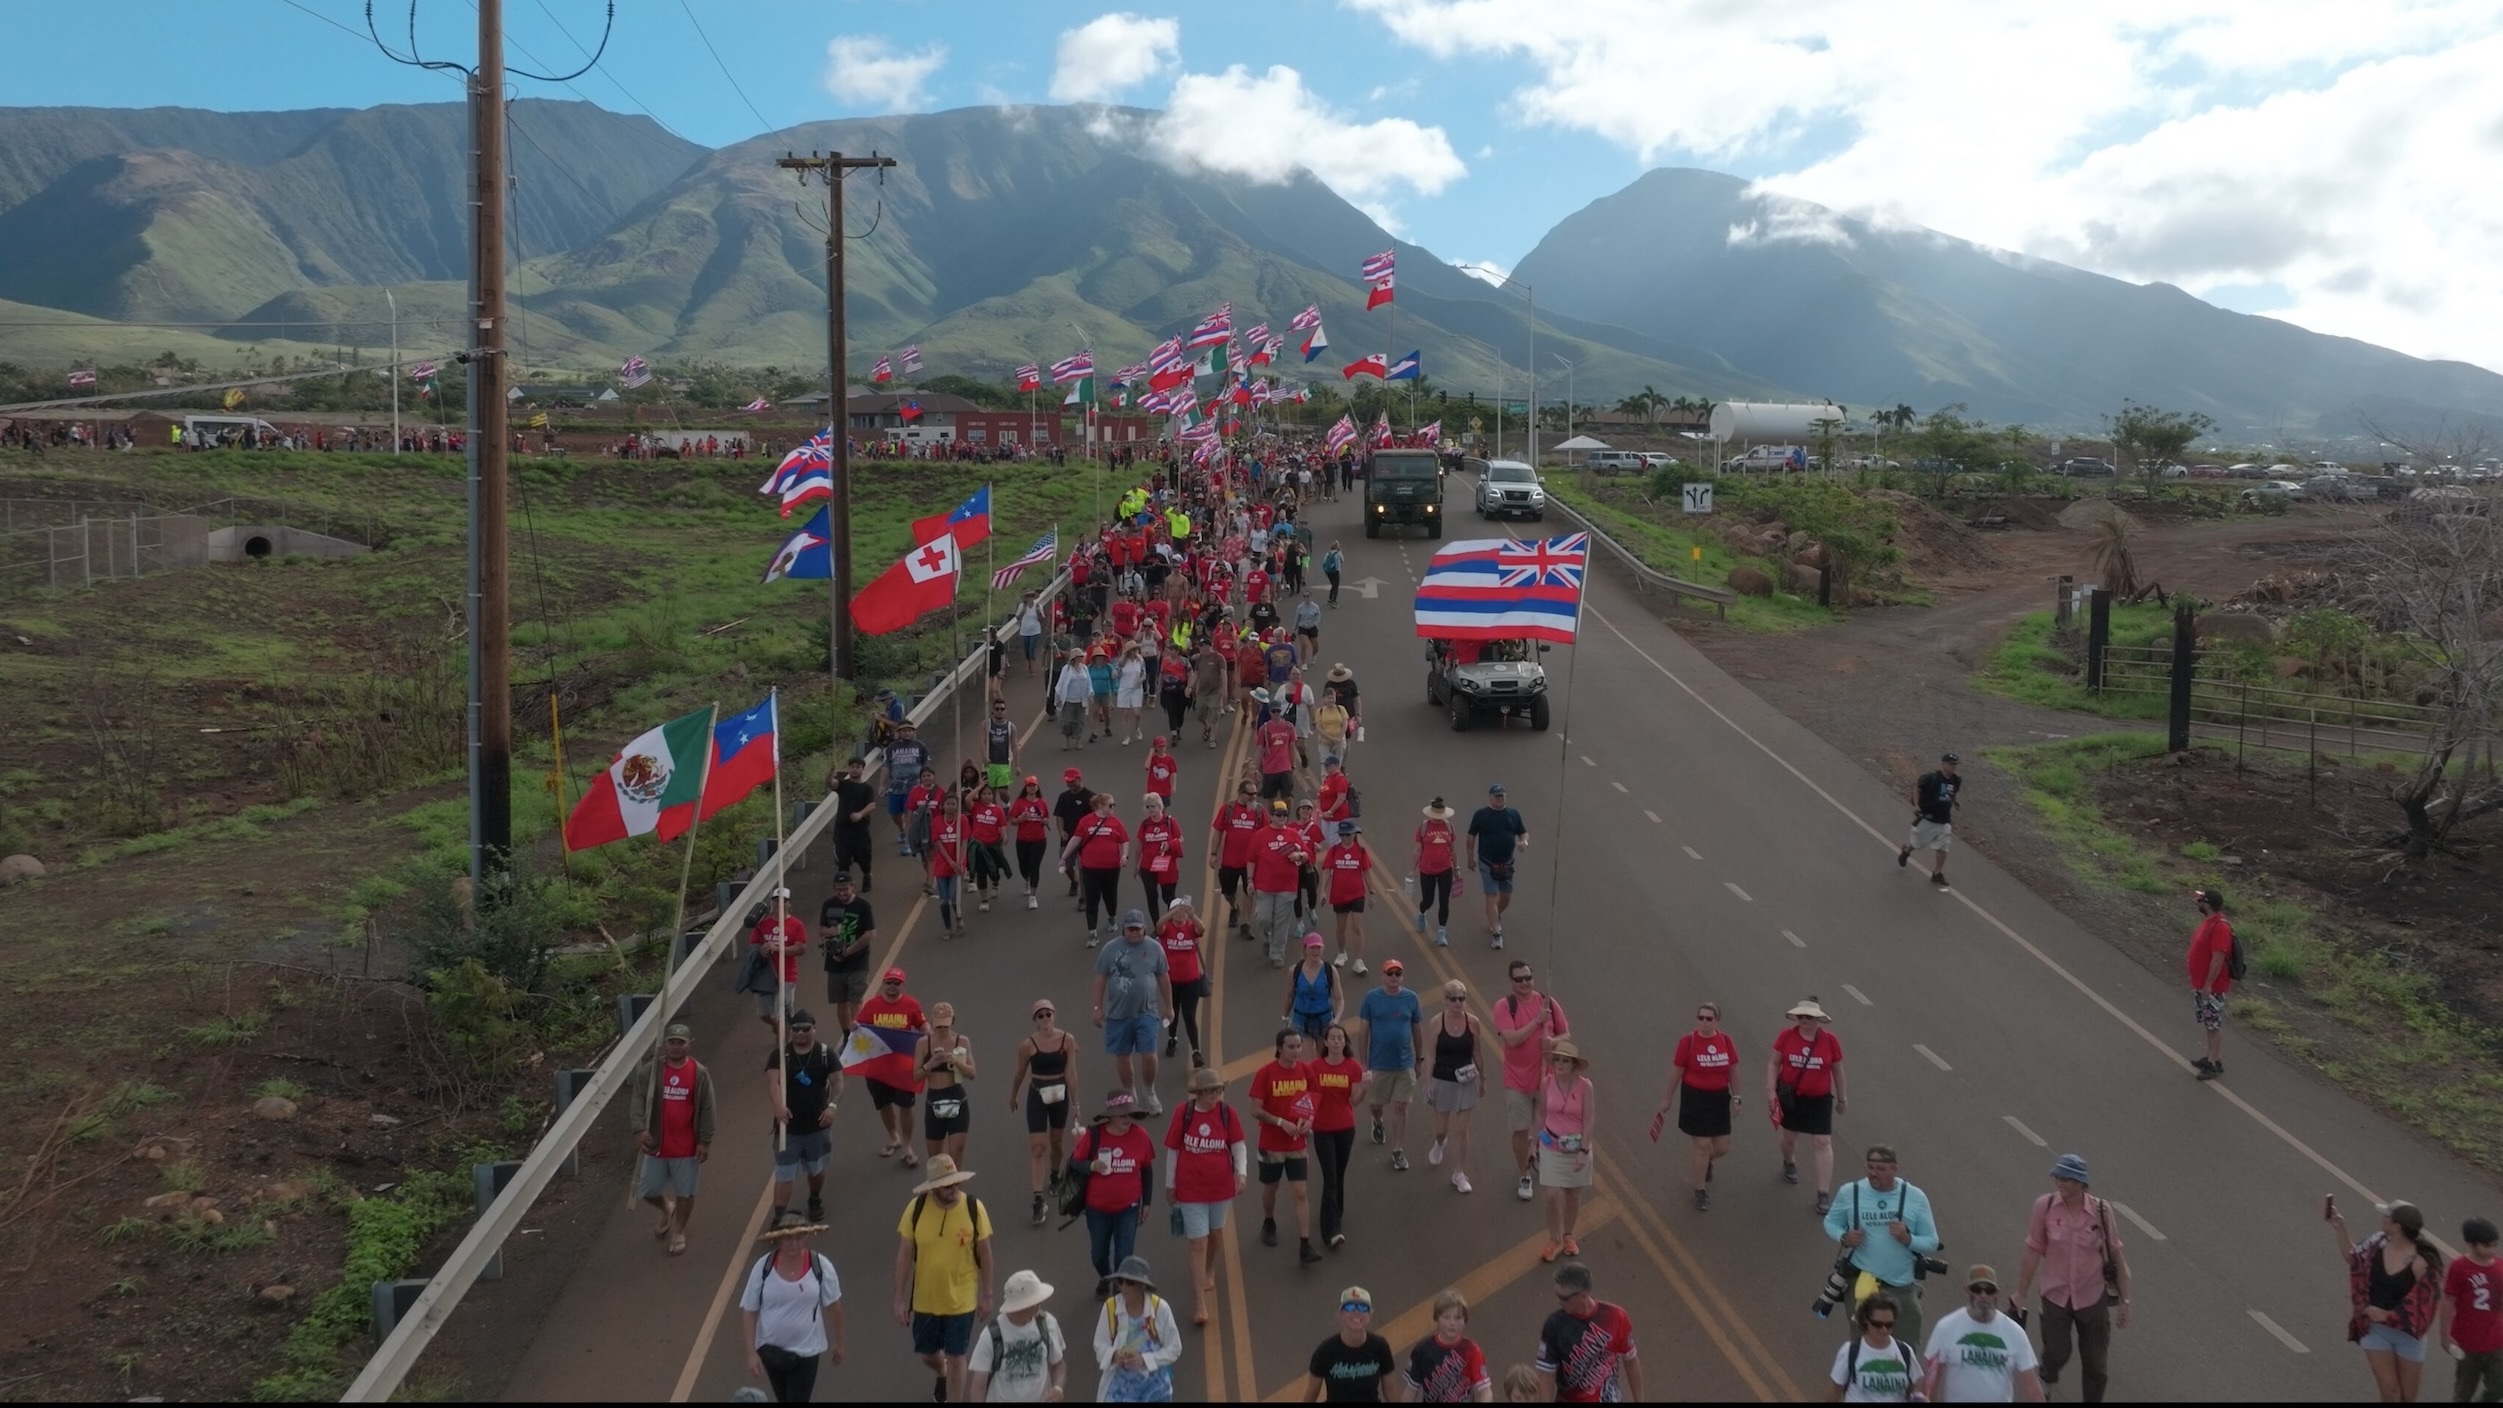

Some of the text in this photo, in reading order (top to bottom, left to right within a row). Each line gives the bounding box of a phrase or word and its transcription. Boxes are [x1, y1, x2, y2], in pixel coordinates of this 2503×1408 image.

[873, 1013, 908, 1027] LAHAINA
[1272, 1079, 1307, 1097] LAHAINA
[1319, 1073, 1349, 1088] LAHAINA
[1200, 1138, 1226, 1150] ALOHA
[1112, 1159, 1136, 1167] ALOHA
[1861, 1211, 1899, 1220] LELE ALOH
[2473, 1288, 2491, 1311] 2
[1961, 1348, 2009, 1368] LAHAINA
[1862, 1373, 1907, 1393] LAHAINA
